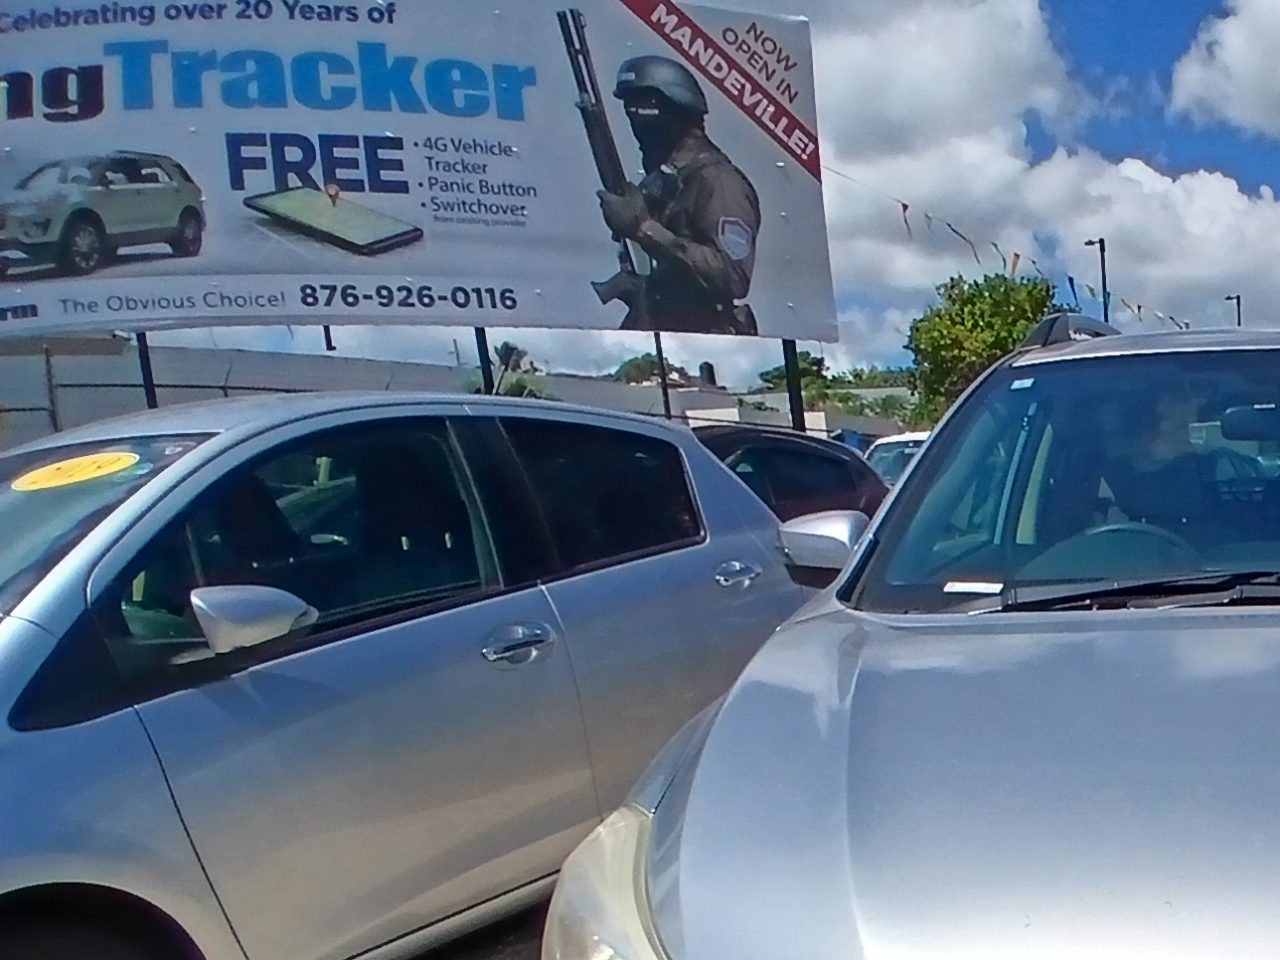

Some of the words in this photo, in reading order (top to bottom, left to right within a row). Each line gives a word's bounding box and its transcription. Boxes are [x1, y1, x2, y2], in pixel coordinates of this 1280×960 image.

[0, 2, 155, 33] Celebrating
[164, 3, 227, 20] over
[233, 0, 273, 19] 20
[282, 0, 359, 22] Years
[367, 2, 397, 24] of
[746, 22, 798, 72] NOW
[722, 27, 776, 82] OPEN
[776, 78, 799, 104] IN
[650, 3, 815, 160] MANDEVILLE!
[423, 137, 448, 152] 4G
[450, 138, 514, 157] Vehicle
[224, 132, 411, 195] FREE
[424, 156, 488, 175] Tracker
[428, 176, 475, 194] Panic
[479, 179, 538, 197] Button
[430, 196, 527, 217] Switchover
[58, 298, 99, 314] The
[106, 295, 196, 312] Obvious
[202, 291, 286, 309] Choice!
[299, 284, 518, 310] 876-926-0116
